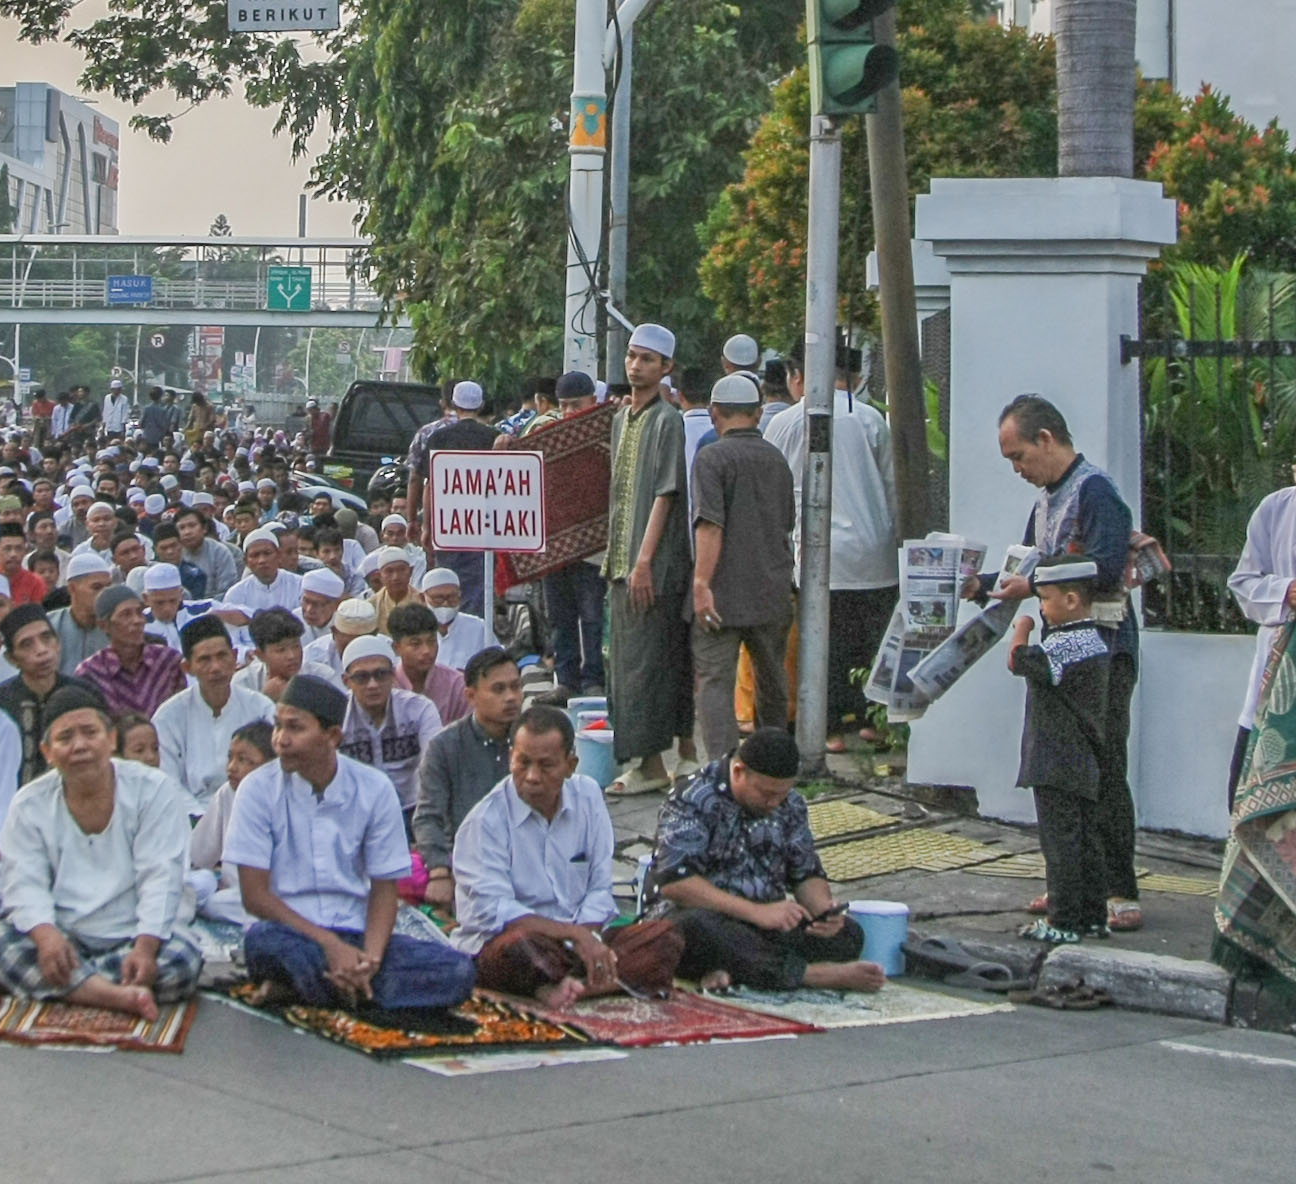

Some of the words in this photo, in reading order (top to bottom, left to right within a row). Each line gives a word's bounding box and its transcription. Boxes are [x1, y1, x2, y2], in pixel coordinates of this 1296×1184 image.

[238, 8, 327, 22] BERIKUT
[442, 468, 530, 496] JAMA'AH
[439, 508, 536, 536] LAKI-LAKI
